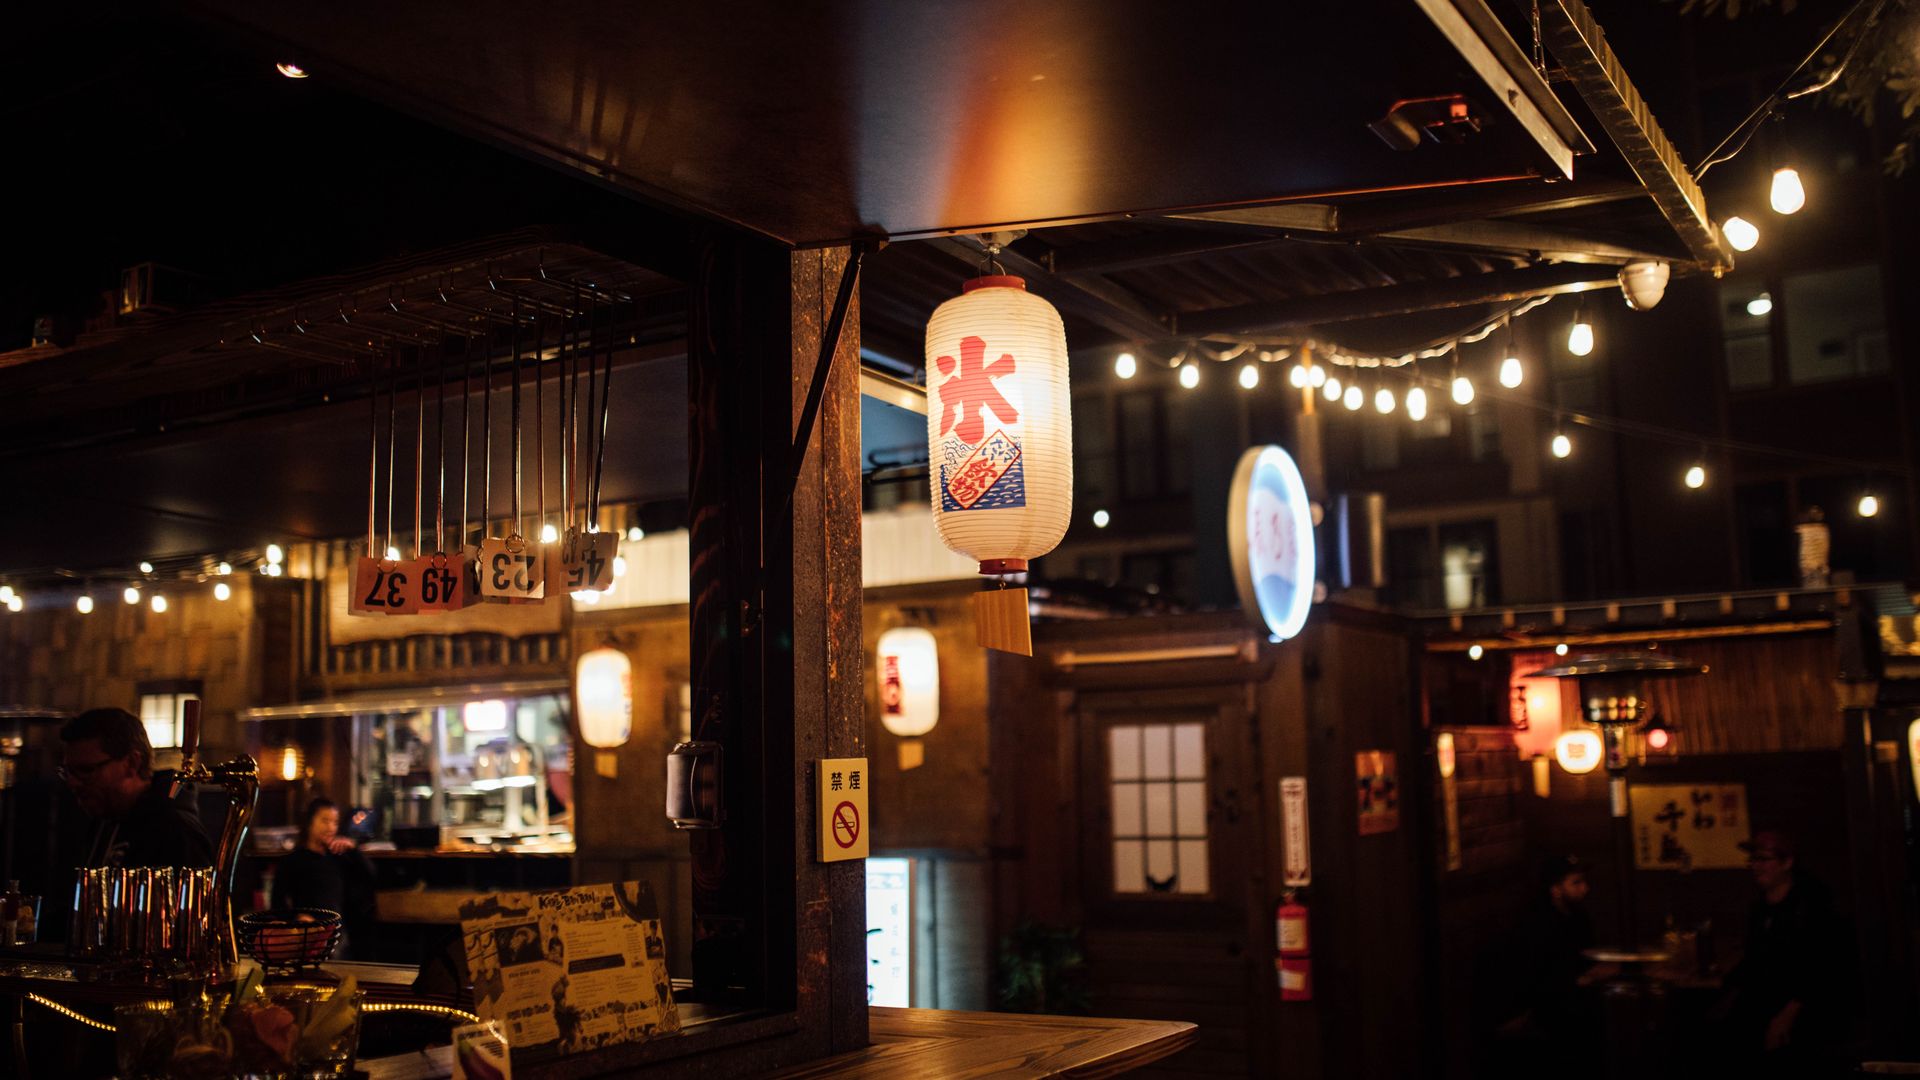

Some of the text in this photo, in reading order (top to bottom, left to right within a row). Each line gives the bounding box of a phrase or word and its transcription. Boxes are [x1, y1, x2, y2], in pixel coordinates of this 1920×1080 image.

[936, 335, 1020, 445] 氷
[365, 571, 407, 608] 37
[422, 567, 458, 604] 49
[492, 552, 537, 591] 23
[831, 771, 861, 791] 禁煙
